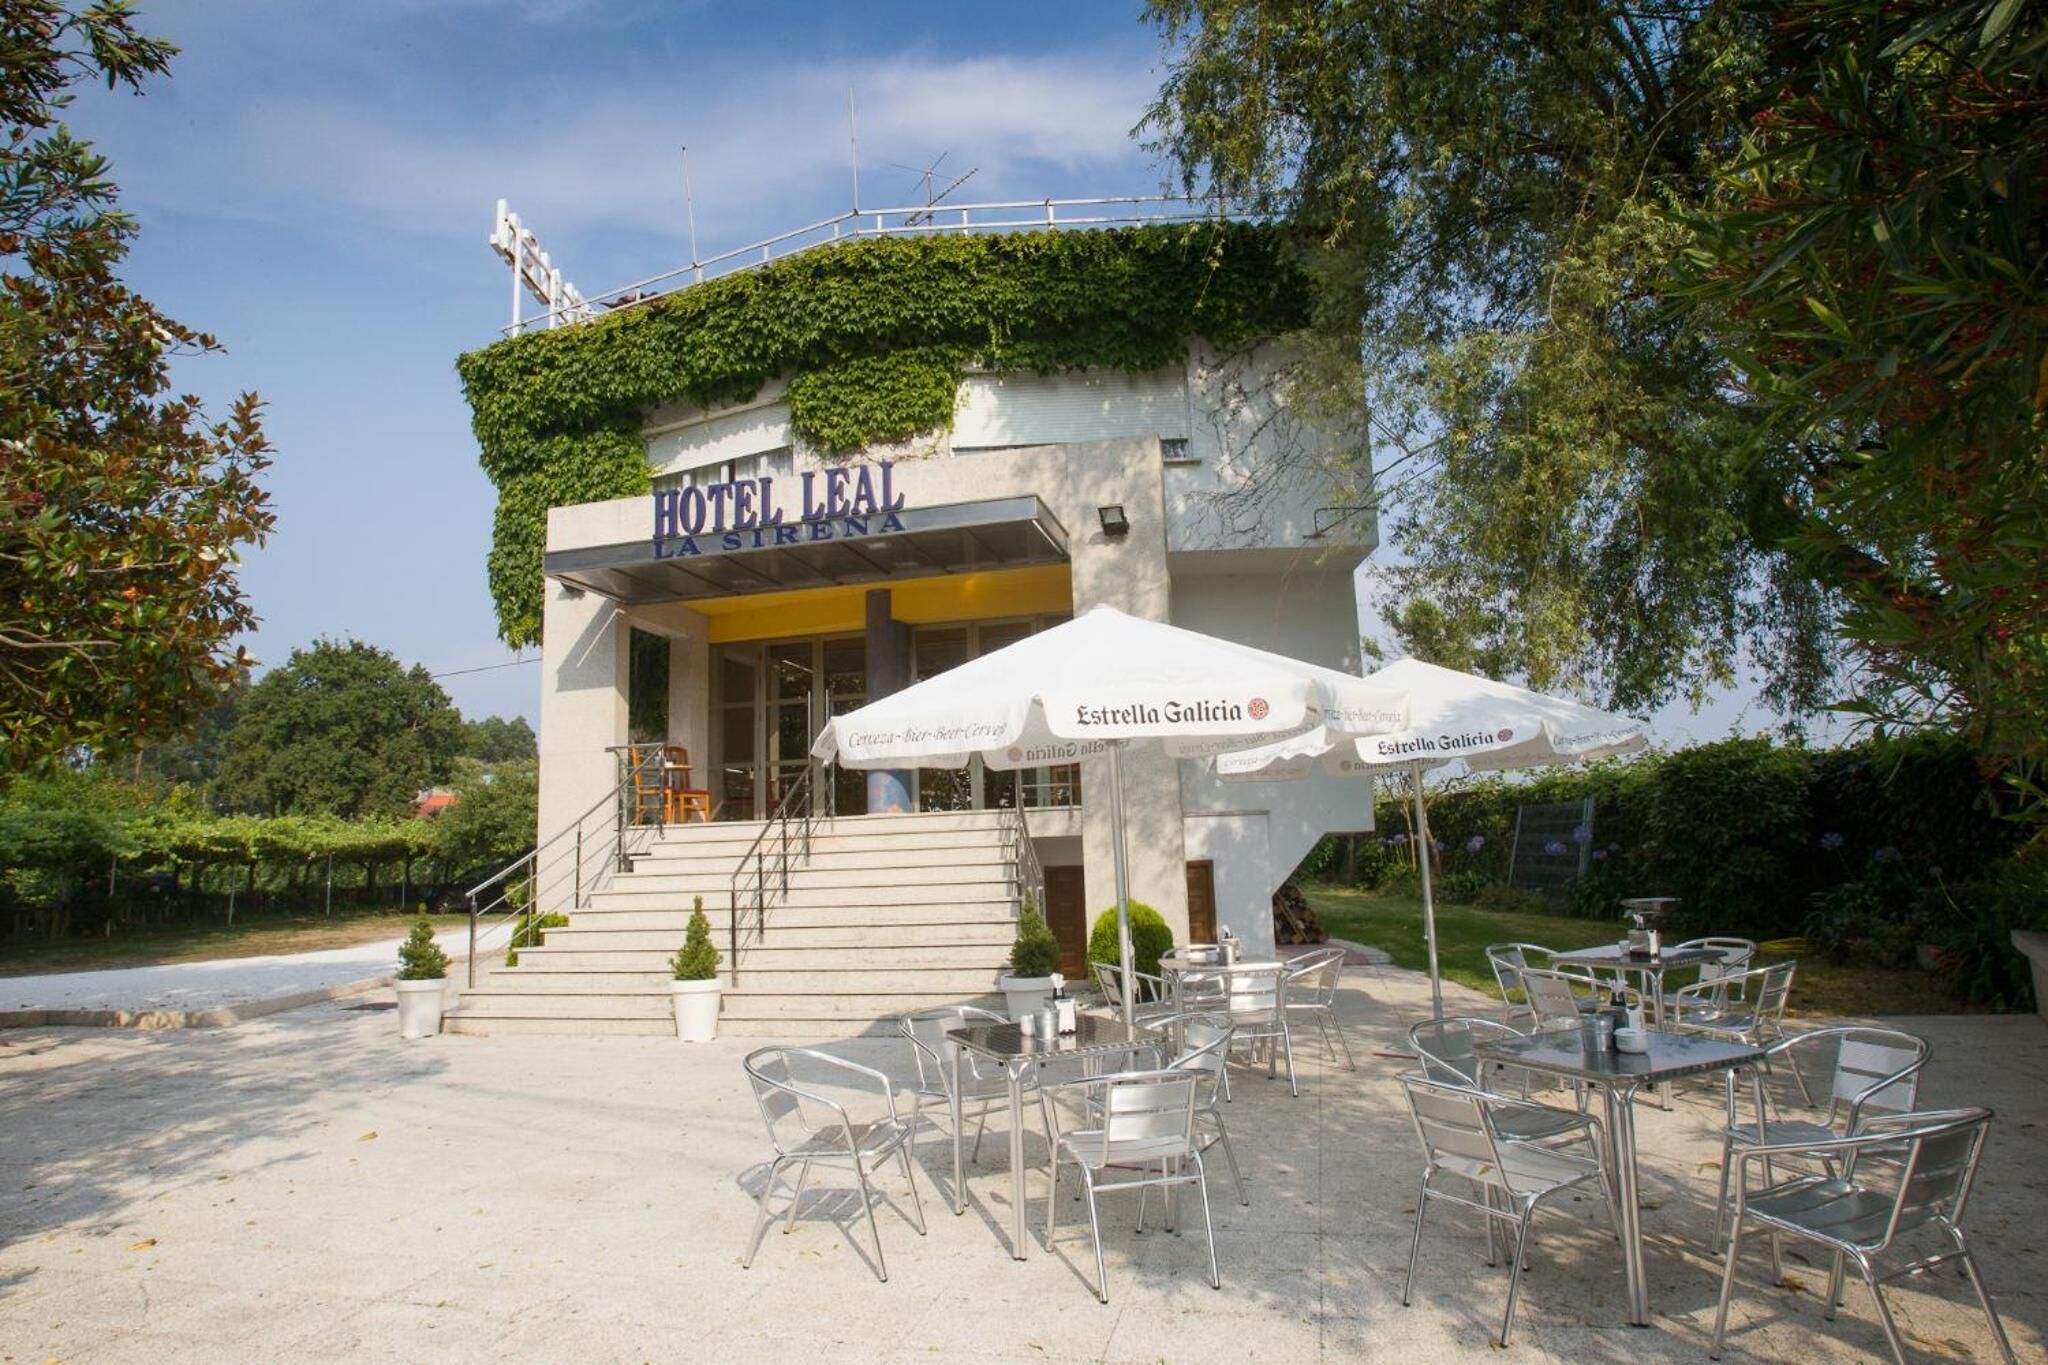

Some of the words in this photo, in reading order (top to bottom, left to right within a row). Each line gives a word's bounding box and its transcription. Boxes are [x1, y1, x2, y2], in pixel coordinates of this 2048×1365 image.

[653, 477, 783, 539] HOTEL
[800, 459, 905, 521] LEAL
[653, 537, 702, 560] LA
[721, 512, 905, 551] SIRENA
[1076, 704, 1160, 726] Estrella
[1164, 699, 1242, 724] Galicia
[1377, 735, 1436, 756] Estrella
[1437, 732, 1494, 752] Galicia
